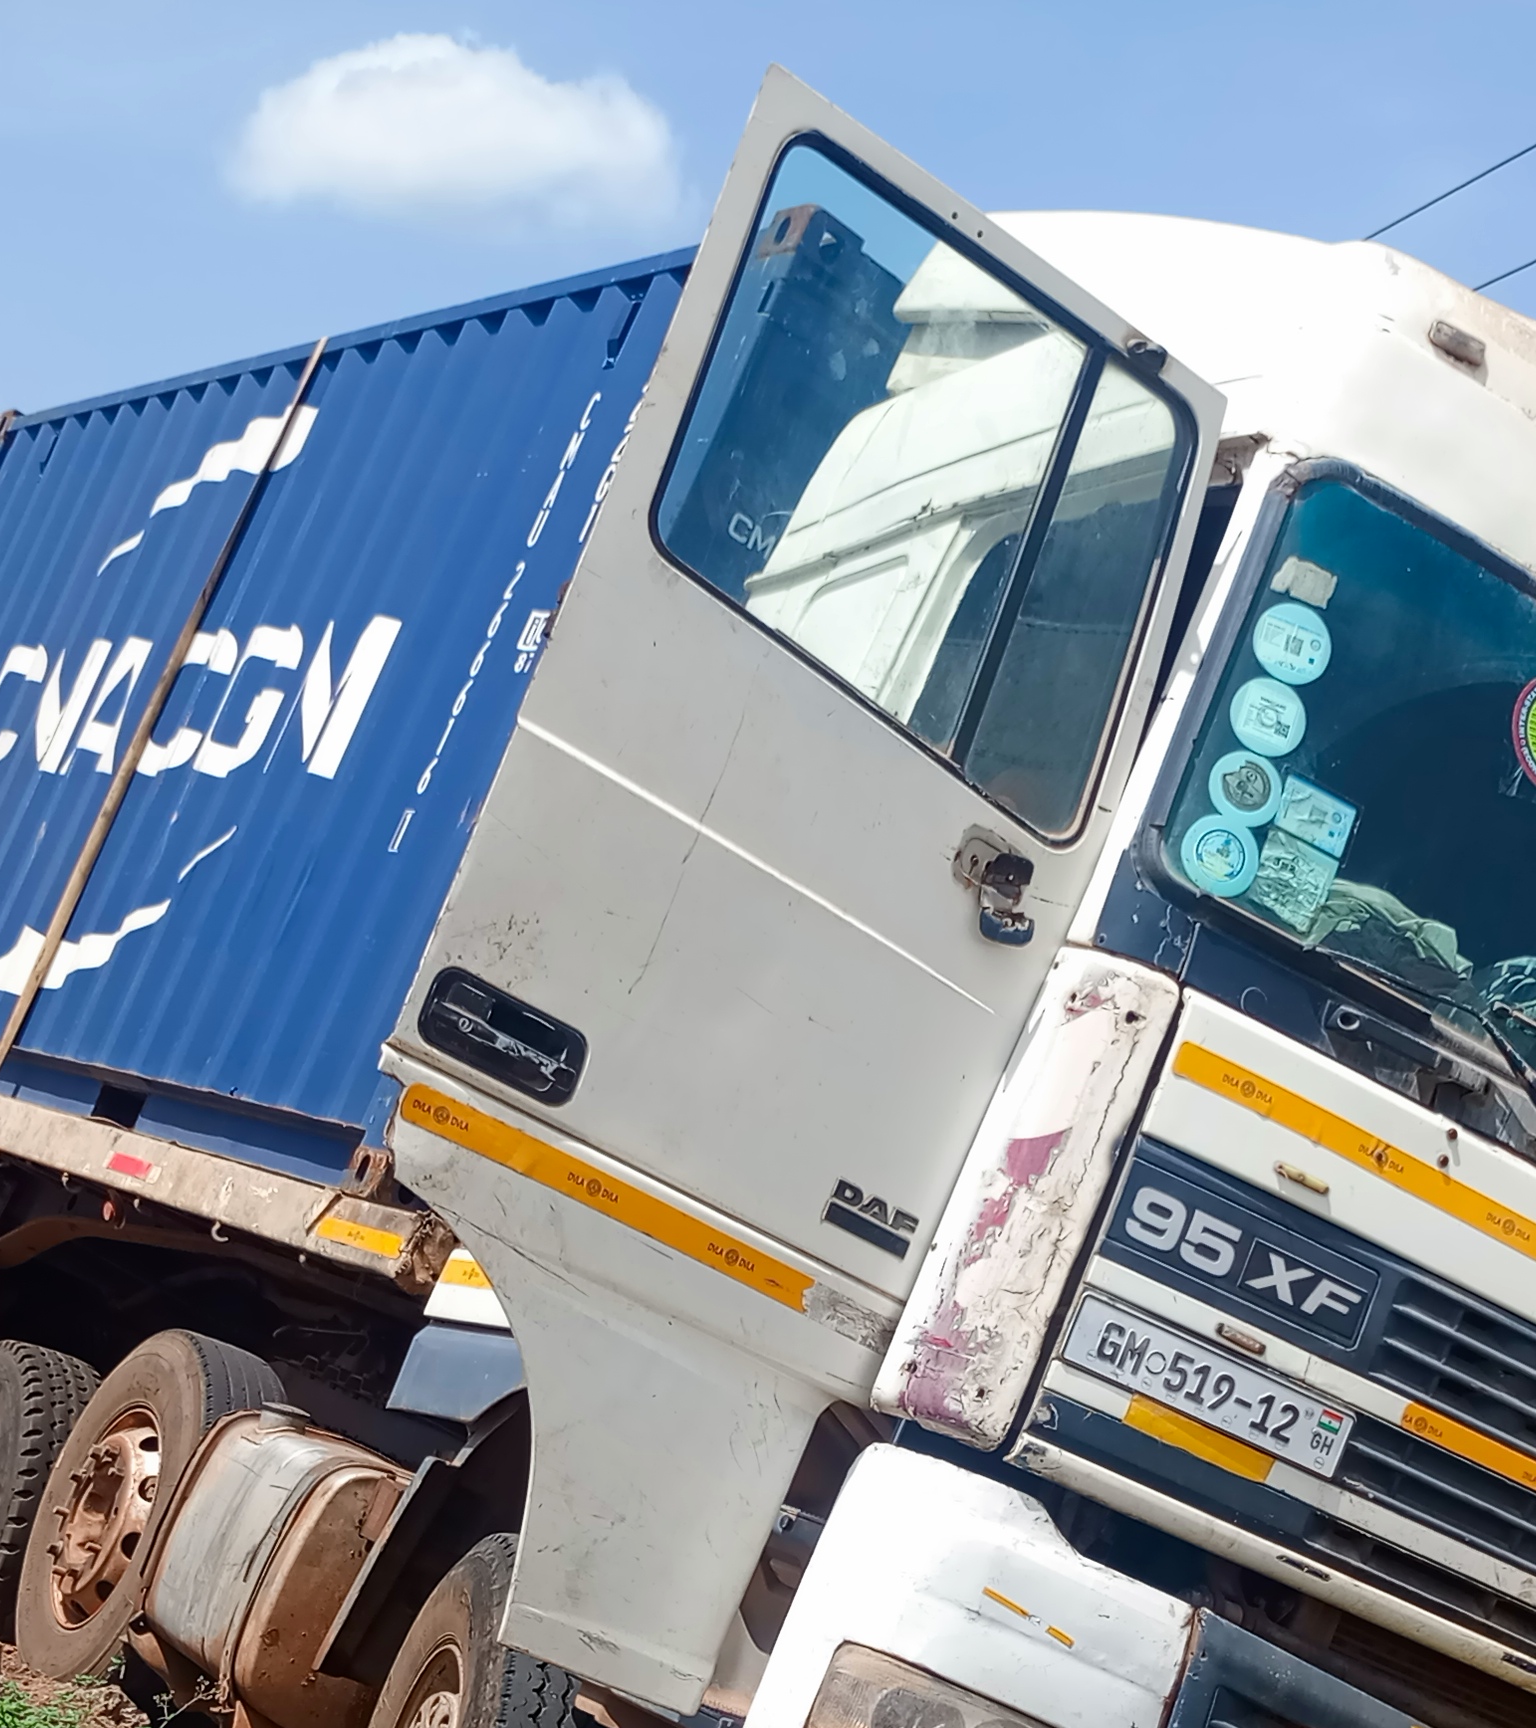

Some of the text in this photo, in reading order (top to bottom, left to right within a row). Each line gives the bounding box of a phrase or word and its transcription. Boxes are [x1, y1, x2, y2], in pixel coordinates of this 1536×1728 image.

[416, 560, 524, 795] 266616
[1221, 1073, 1240, 1089] DVLA
[1255, 1090, 1273, 1105] DVLA
[412, 1099, 756, 1273] DVLA DVLA DVLA DVLA DVLA DVLA
[831, 1178, 920, 1234] DAF
[1124, 1186, 1363, 1315] 95 XF
[1163, 1351, 1300, 1445] 519-12
[1309, 1431, 1334, 1456] GH
